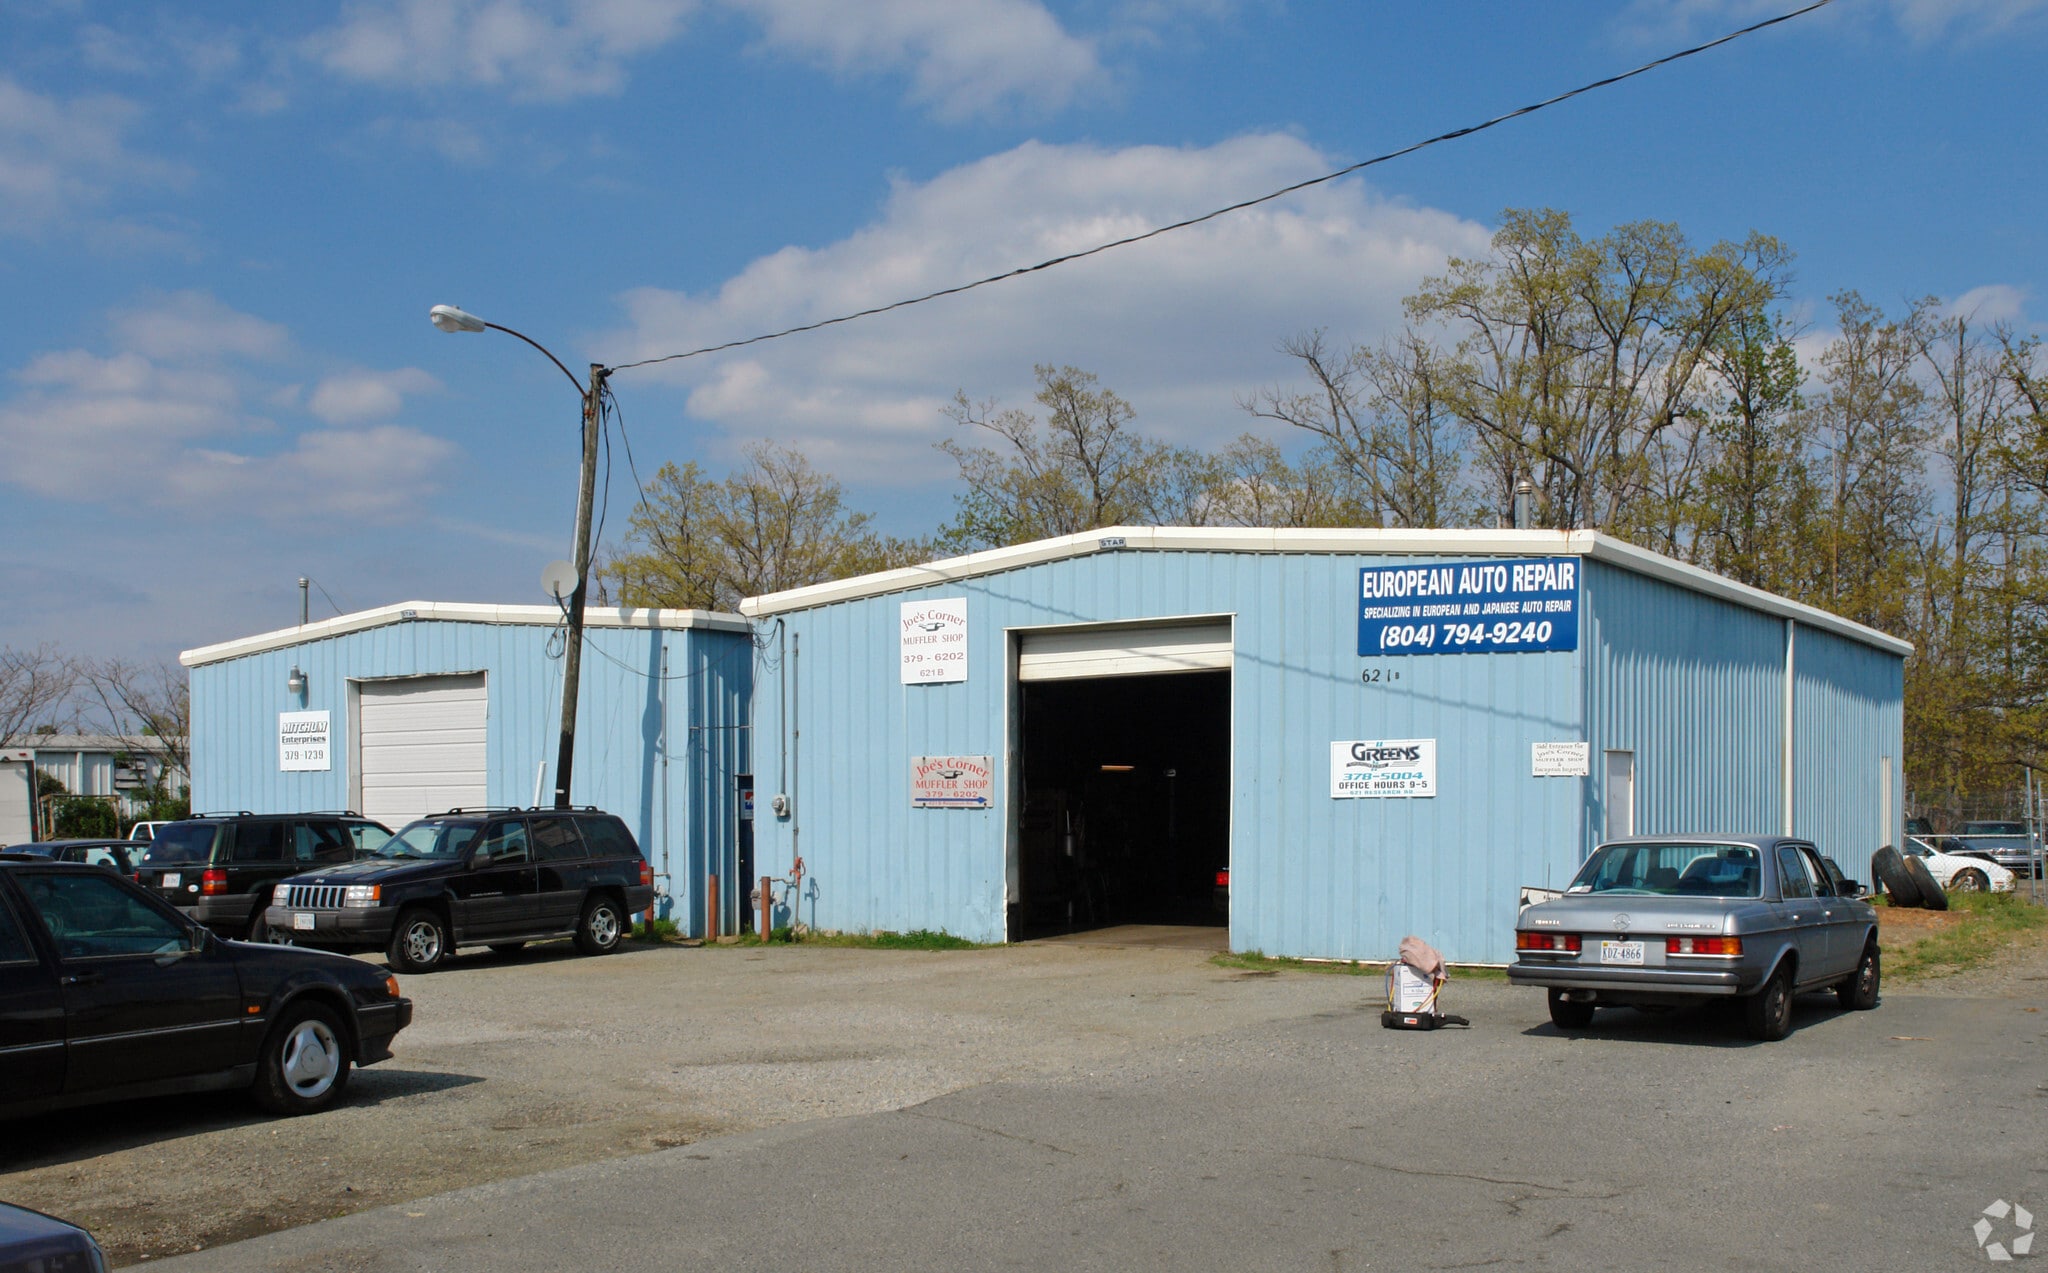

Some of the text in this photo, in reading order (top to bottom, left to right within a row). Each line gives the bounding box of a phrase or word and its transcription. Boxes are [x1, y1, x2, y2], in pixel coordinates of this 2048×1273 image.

[1101, 539, 1124, 547] STAR
[1363, 563, 1575, 599] EUROPEAN AUTO REPAIR
[1364, 600, 1572, 619] SPECIALIZING IN EUROPEAN AND JAPANESE AUTO REPAIR
[903, 610, 966, 632] Joe's Corner
[903, 633, 963, 645] MUFFLER SHOP
[1380, 621, 1552, 649] (804) 794-9240
[903, 654, 923, 663] 379
[934, 652, 964, 661] 6202
[281, 735, 326, 744] Enterprises
[916, 757, 990, 780] Joe's Corner
[1343, 772, 1423, 781] 378-5004
[915, 780, 988, 789] MUFFLER SHOP
[1338, 780, 1428, 790] OFFICE HOURS 9-5
